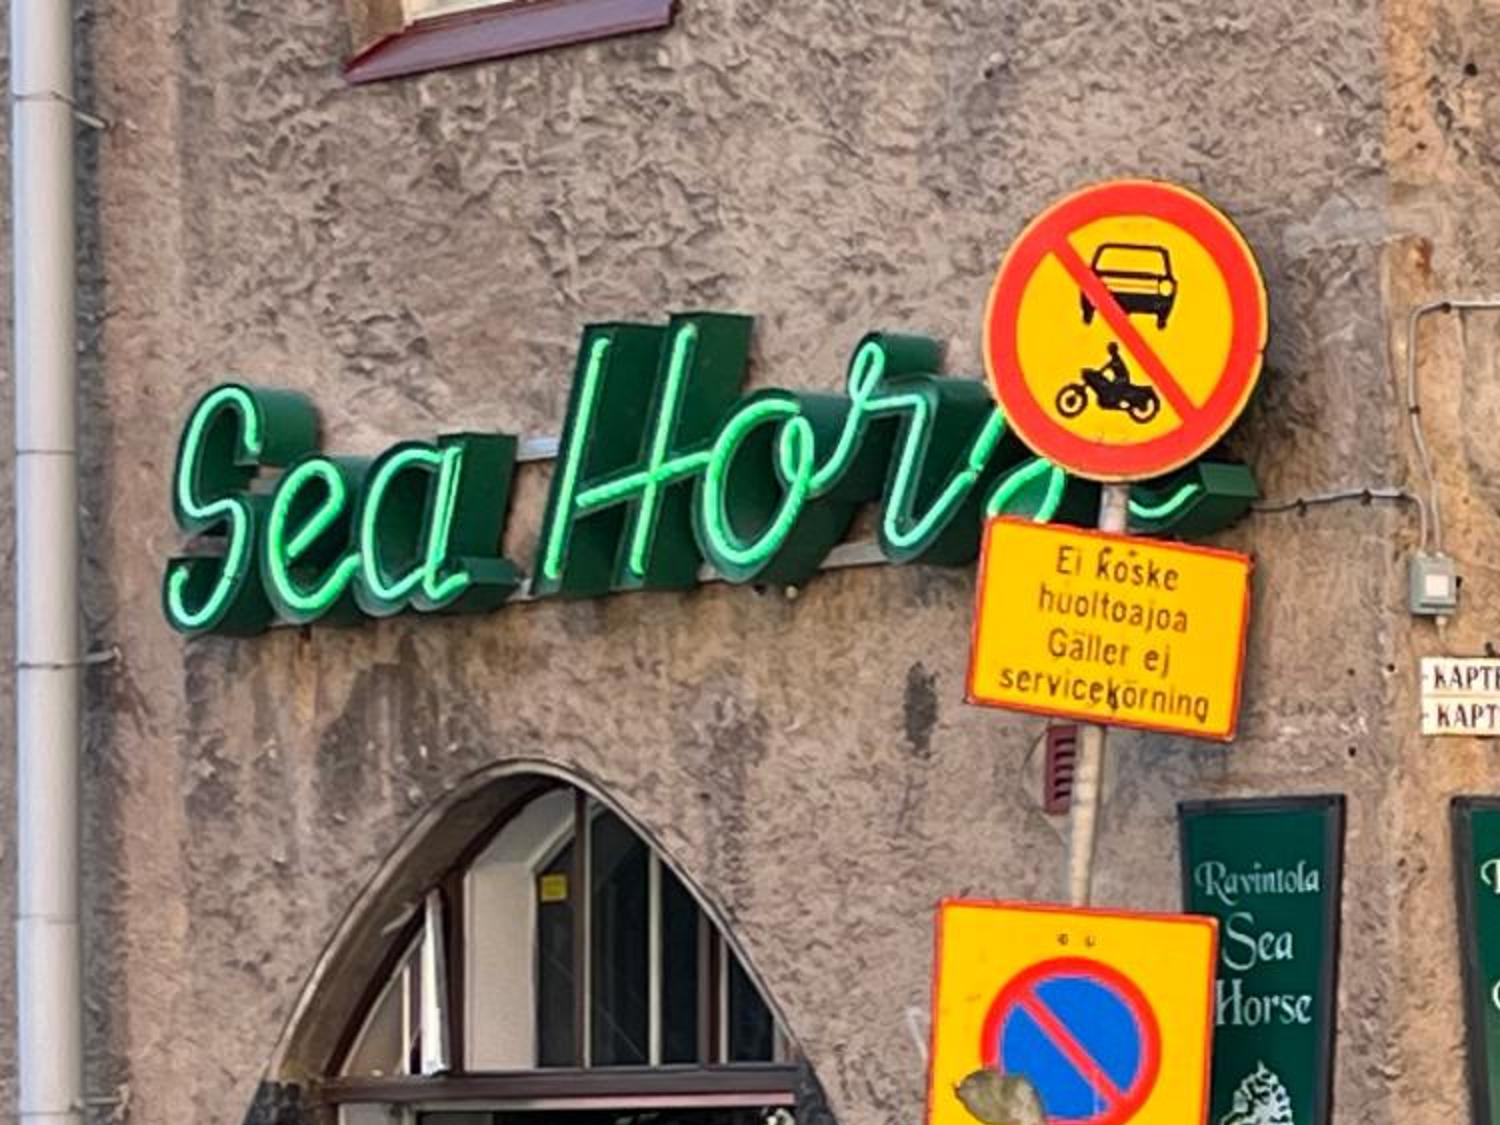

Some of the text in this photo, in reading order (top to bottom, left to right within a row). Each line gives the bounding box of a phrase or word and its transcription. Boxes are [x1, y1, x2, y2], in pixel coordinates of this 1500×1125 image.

[166, 320, 1201, 630] Sea Hor
[1056, 545, 1180, 592] Ei koske
[1038, 581, 1189, 634] huoltoajoa
[1048, 627, 1171, 680] Gäller ej
[999, 665, 1210, 724] servicekörning
[1194, 859, 1321, 907] Ravintola
[1221, 911, 1295, 971] Sea
[1215, 978, 1314, 1027] Horse
